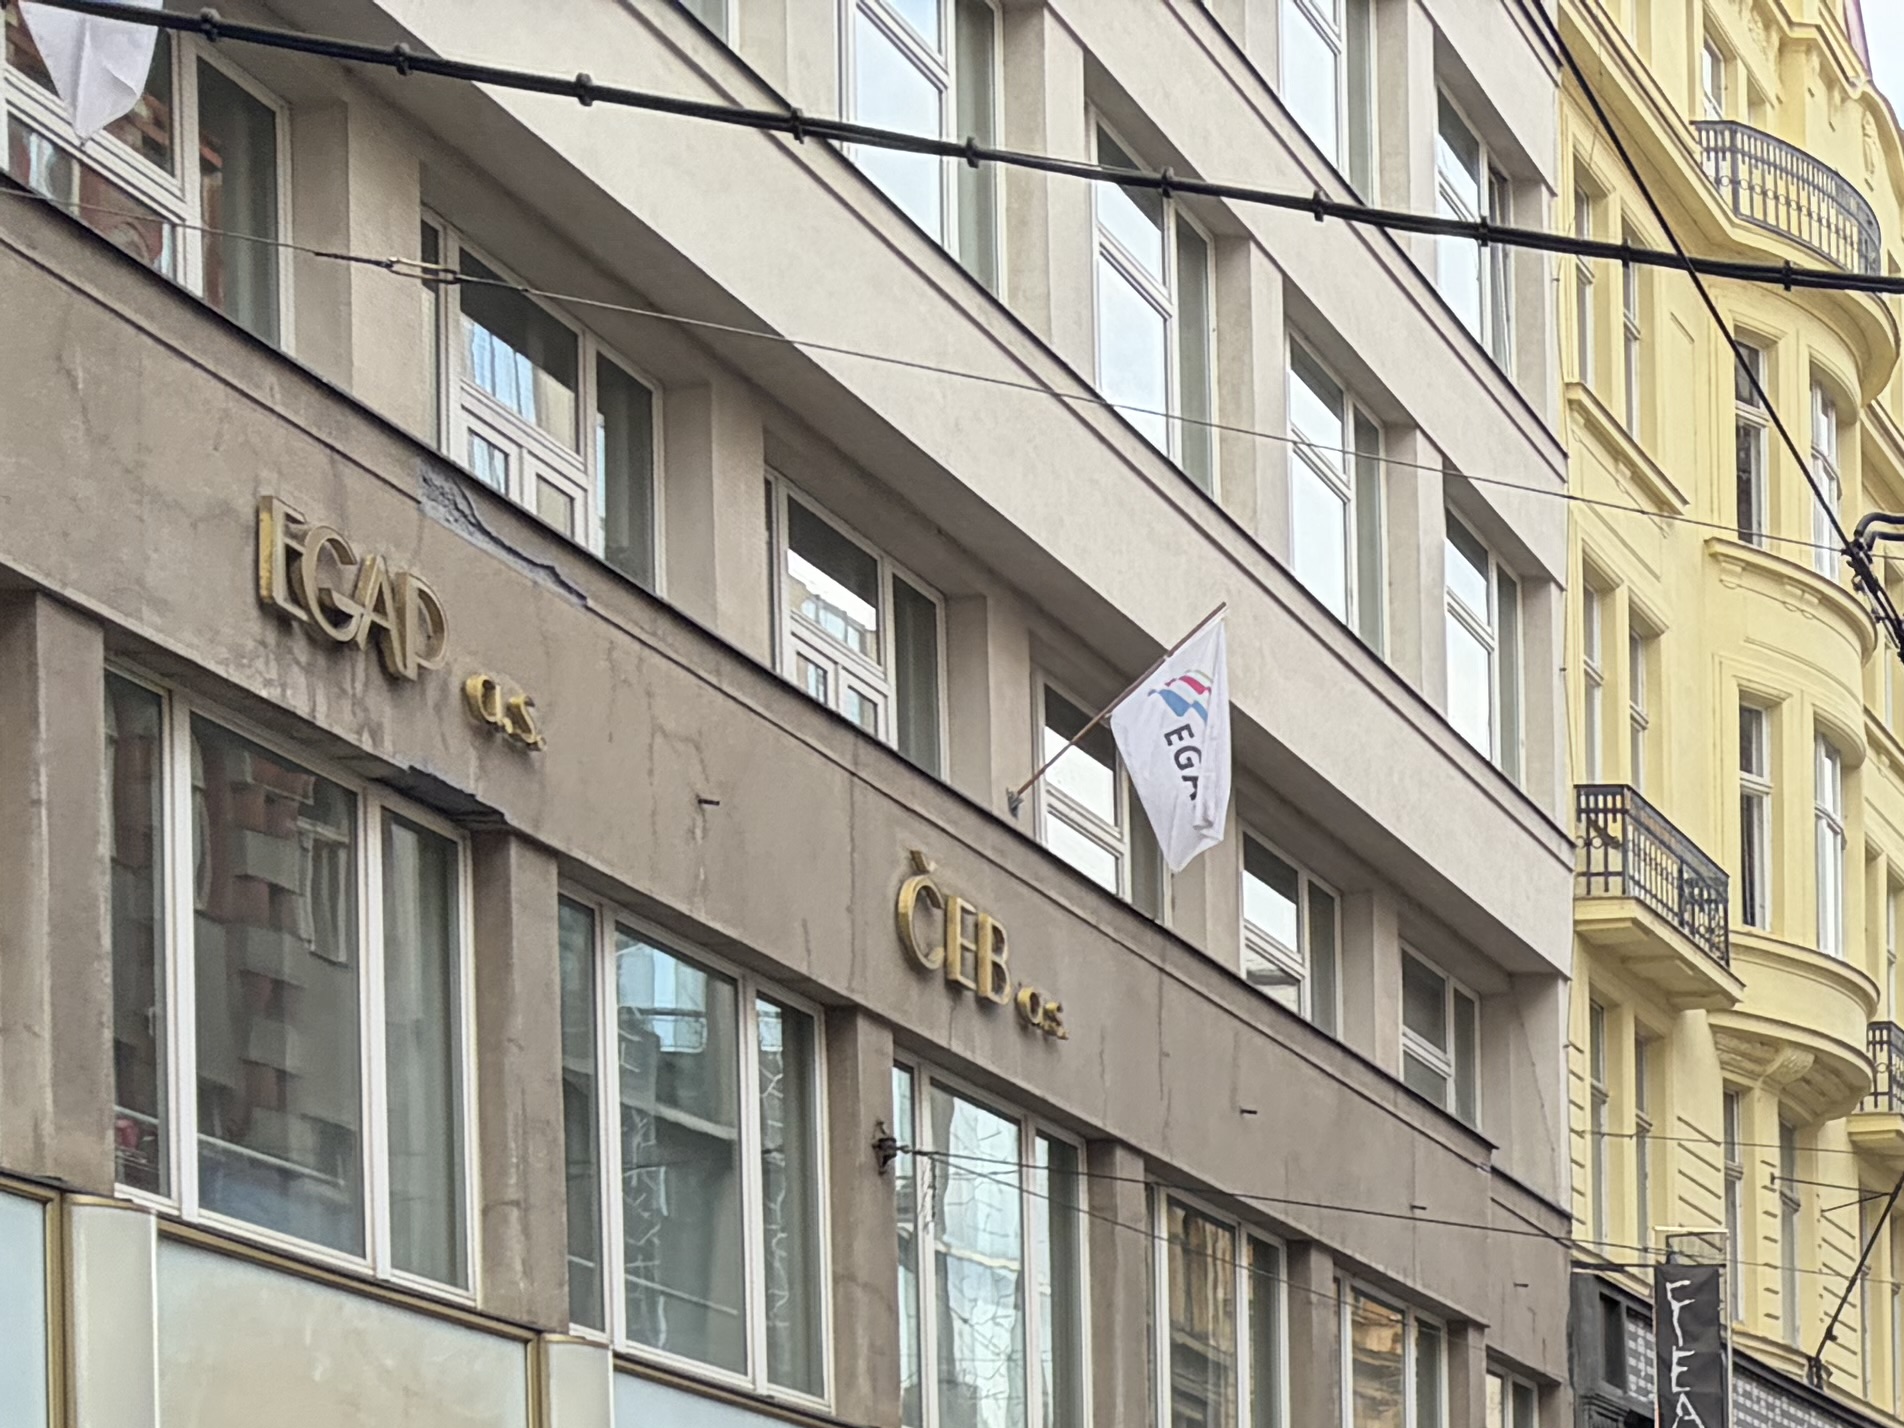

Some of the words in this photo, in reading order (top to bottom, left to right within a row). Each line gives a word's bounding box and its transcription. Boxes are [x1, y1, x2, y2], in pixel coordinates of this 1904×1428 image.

[258, 495, 449, 681] EGAP
[1164, 723, 1203, 802] EGA
[899, 850, 1011, 1006] ČEB
